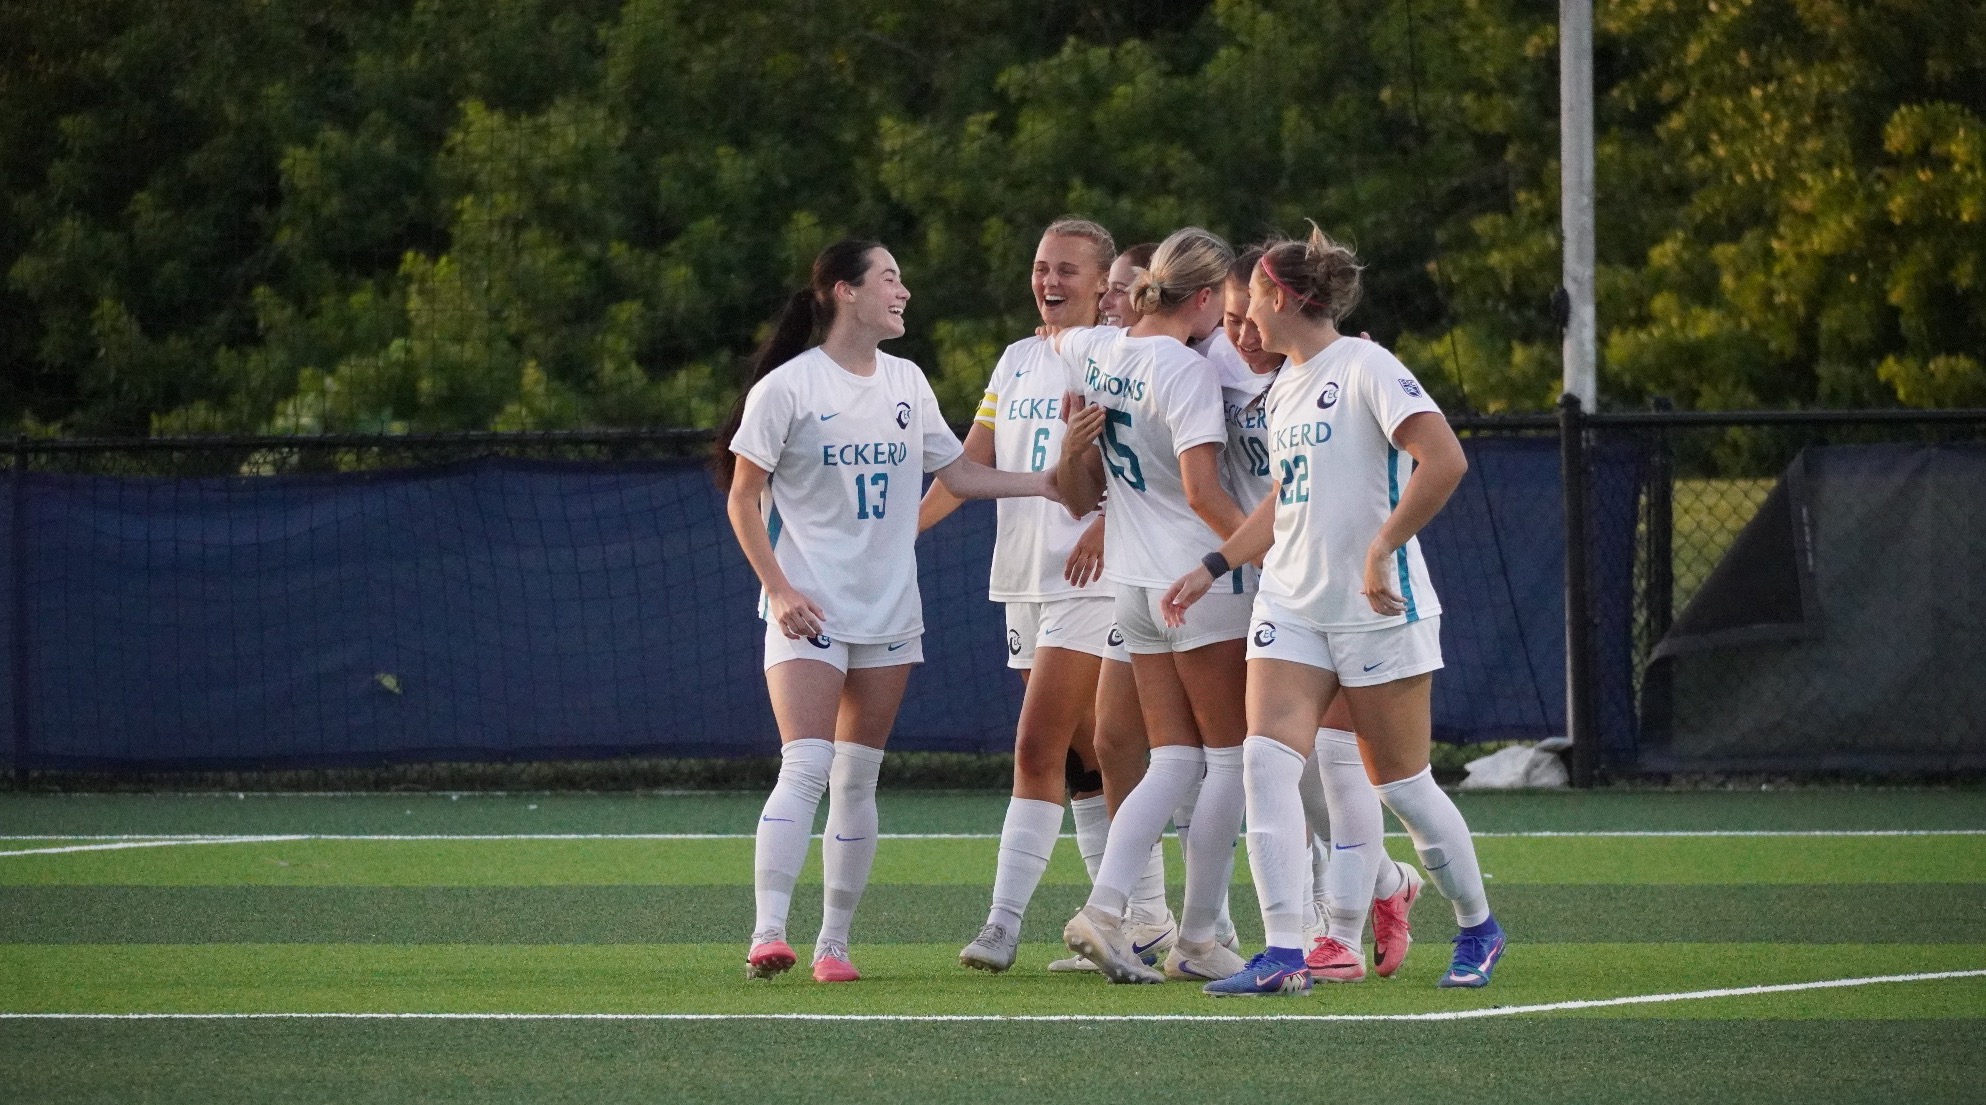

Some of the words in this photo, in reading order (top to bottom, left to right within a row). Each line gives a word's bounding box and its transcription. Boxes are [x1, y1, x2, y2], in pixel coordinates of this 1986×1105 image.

[1084, 358, 1145, 401] TRITONS
[1008, 398, 1062, 420] ECKE
[823, 442, 907, 466] ECKERD
[1031, 427, 1050, 472] 6
[855, 472, 889, 520] 13
[1280, 454, 1310, 505] 22
